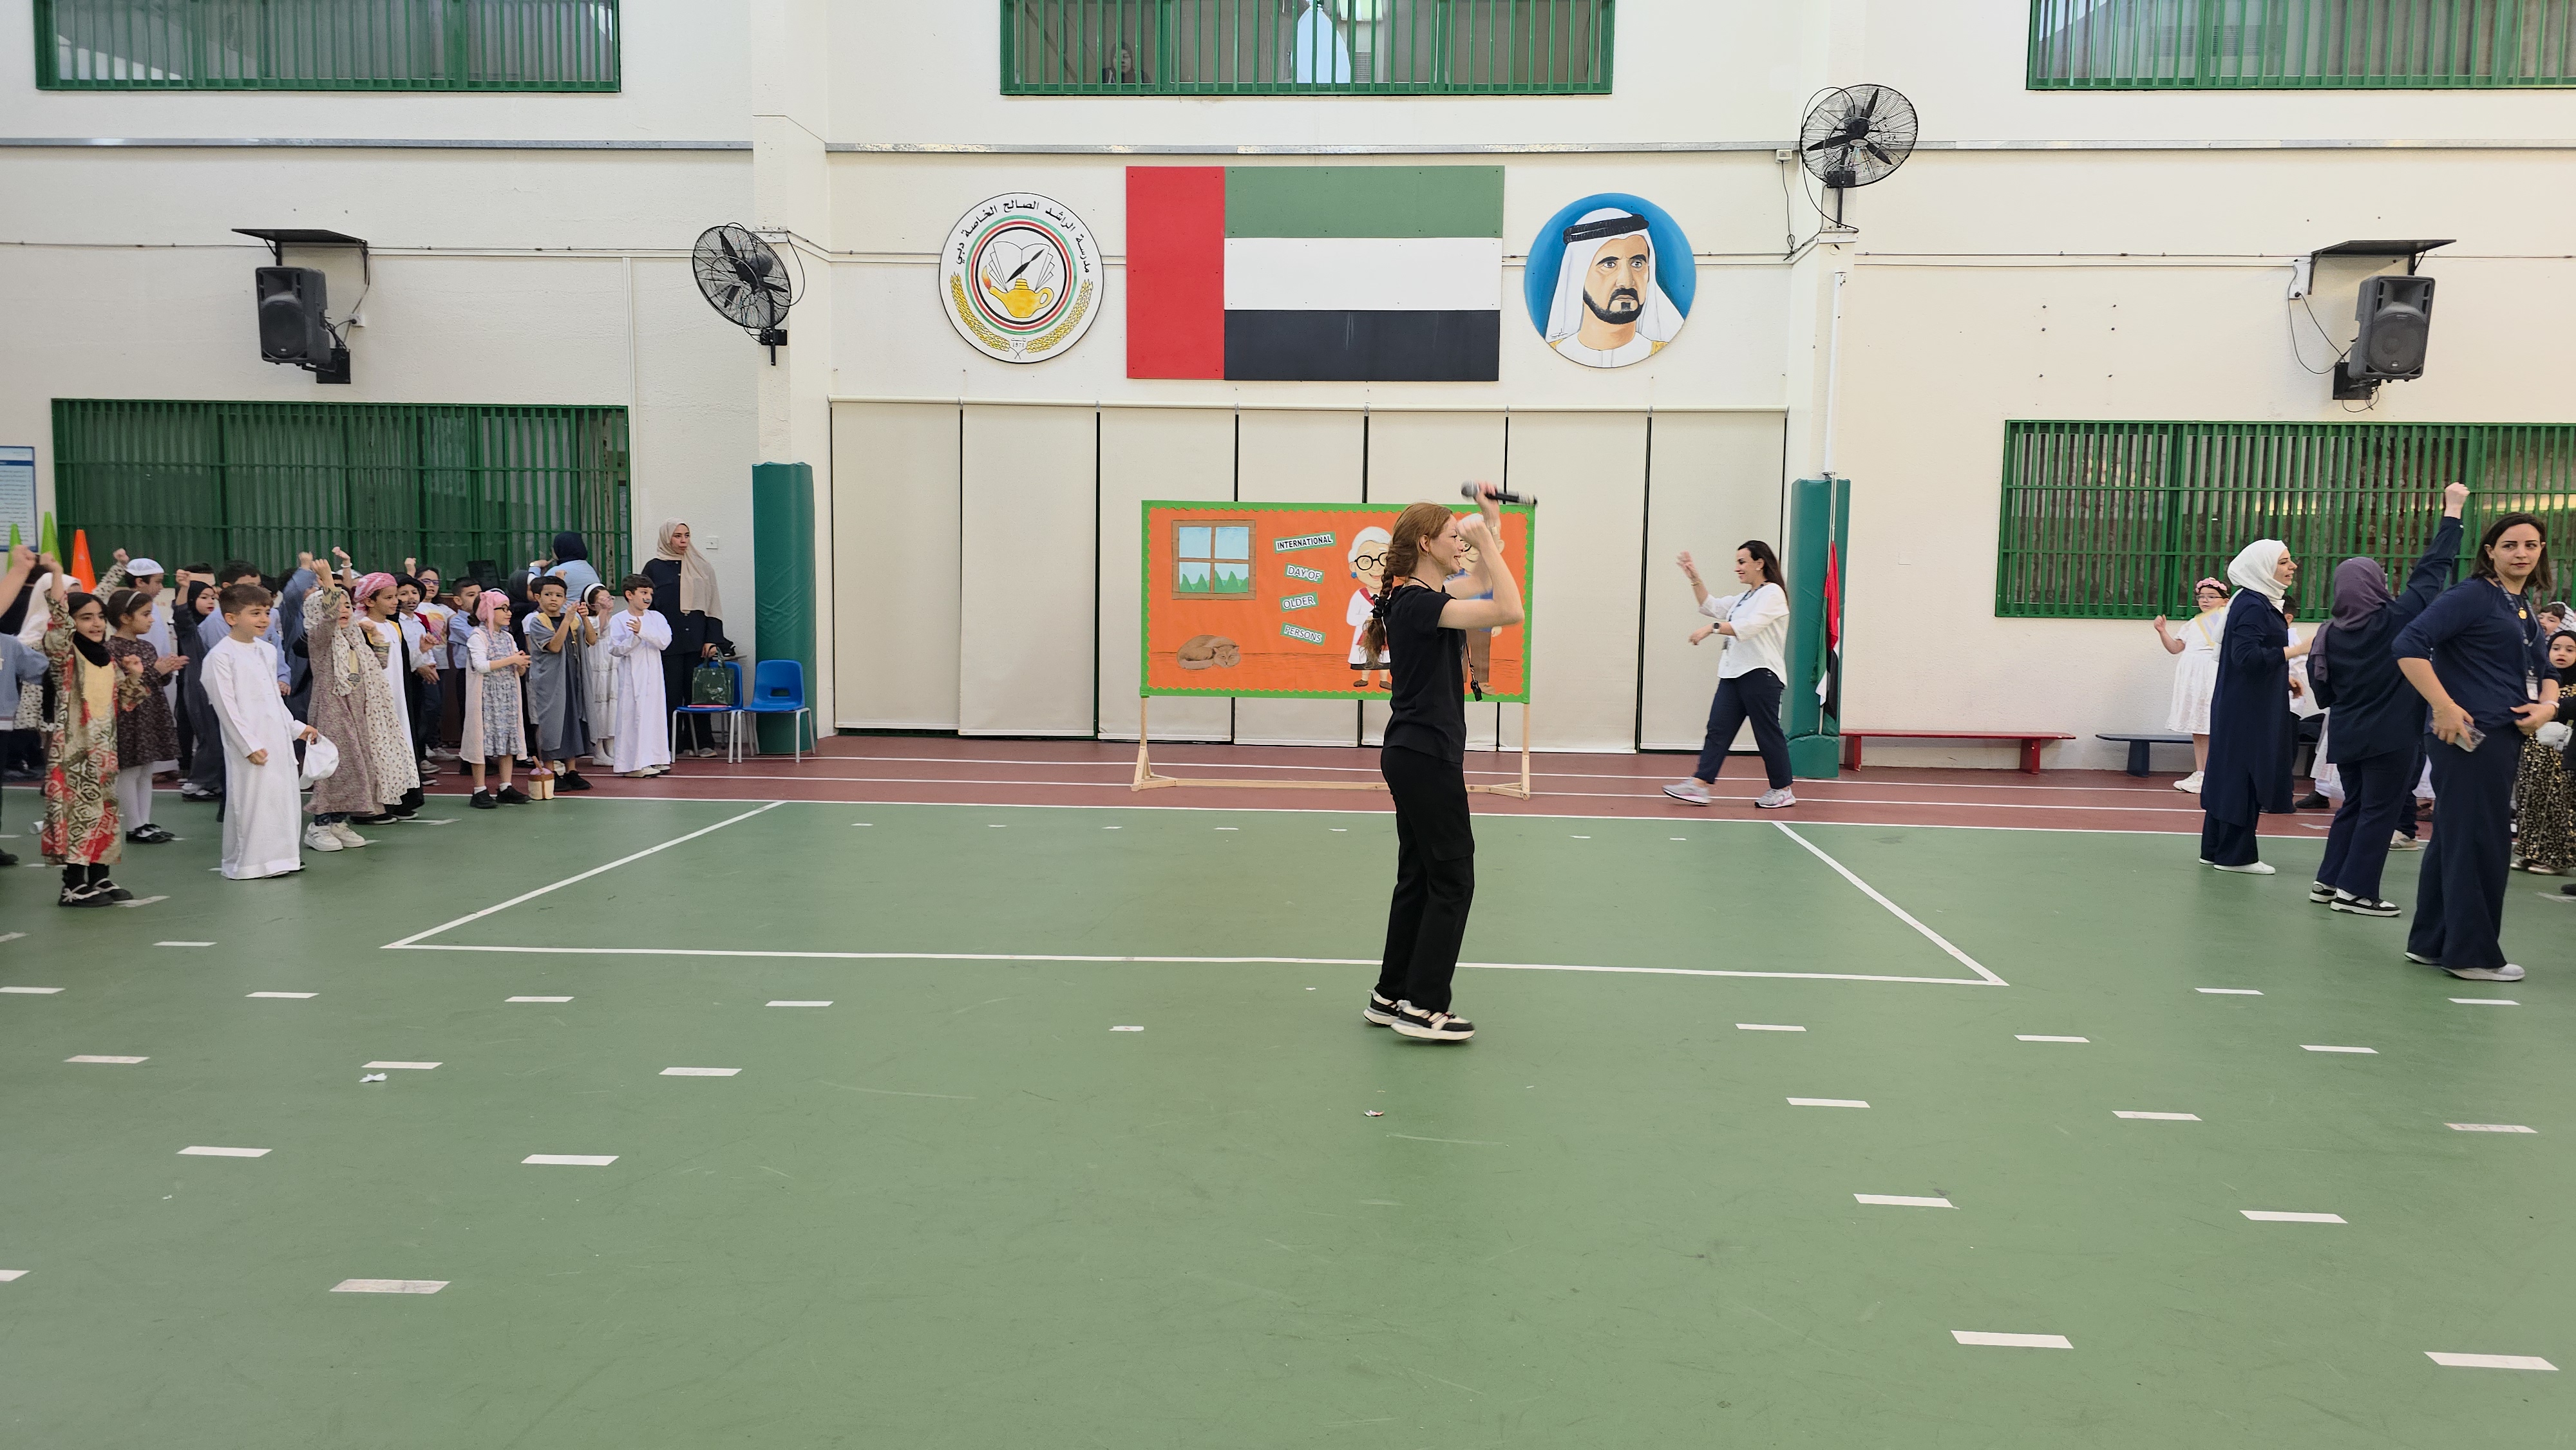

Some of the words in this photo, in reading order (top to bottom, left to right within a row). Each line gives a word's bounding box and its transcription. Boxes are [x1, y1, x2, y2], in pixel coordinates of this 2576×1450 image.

[1003, 200, 1039, 213] الصالح
[961, 205, 998, 238] الخاصة
[1045, 207, 1076, 232] الراشد
[956, 242, 965, 265] دبي
[1075, 234, 1090, 273] مدرسة
[1277, 535, 1332, 549] INTERNATIONAL
[1288, 567, 1306, 577] DAY
[1308, 571, 1321, 580] OF
[1283, 596, 1314, 608] OLDER
[1285, 626, 1321, 642] PERSONS
